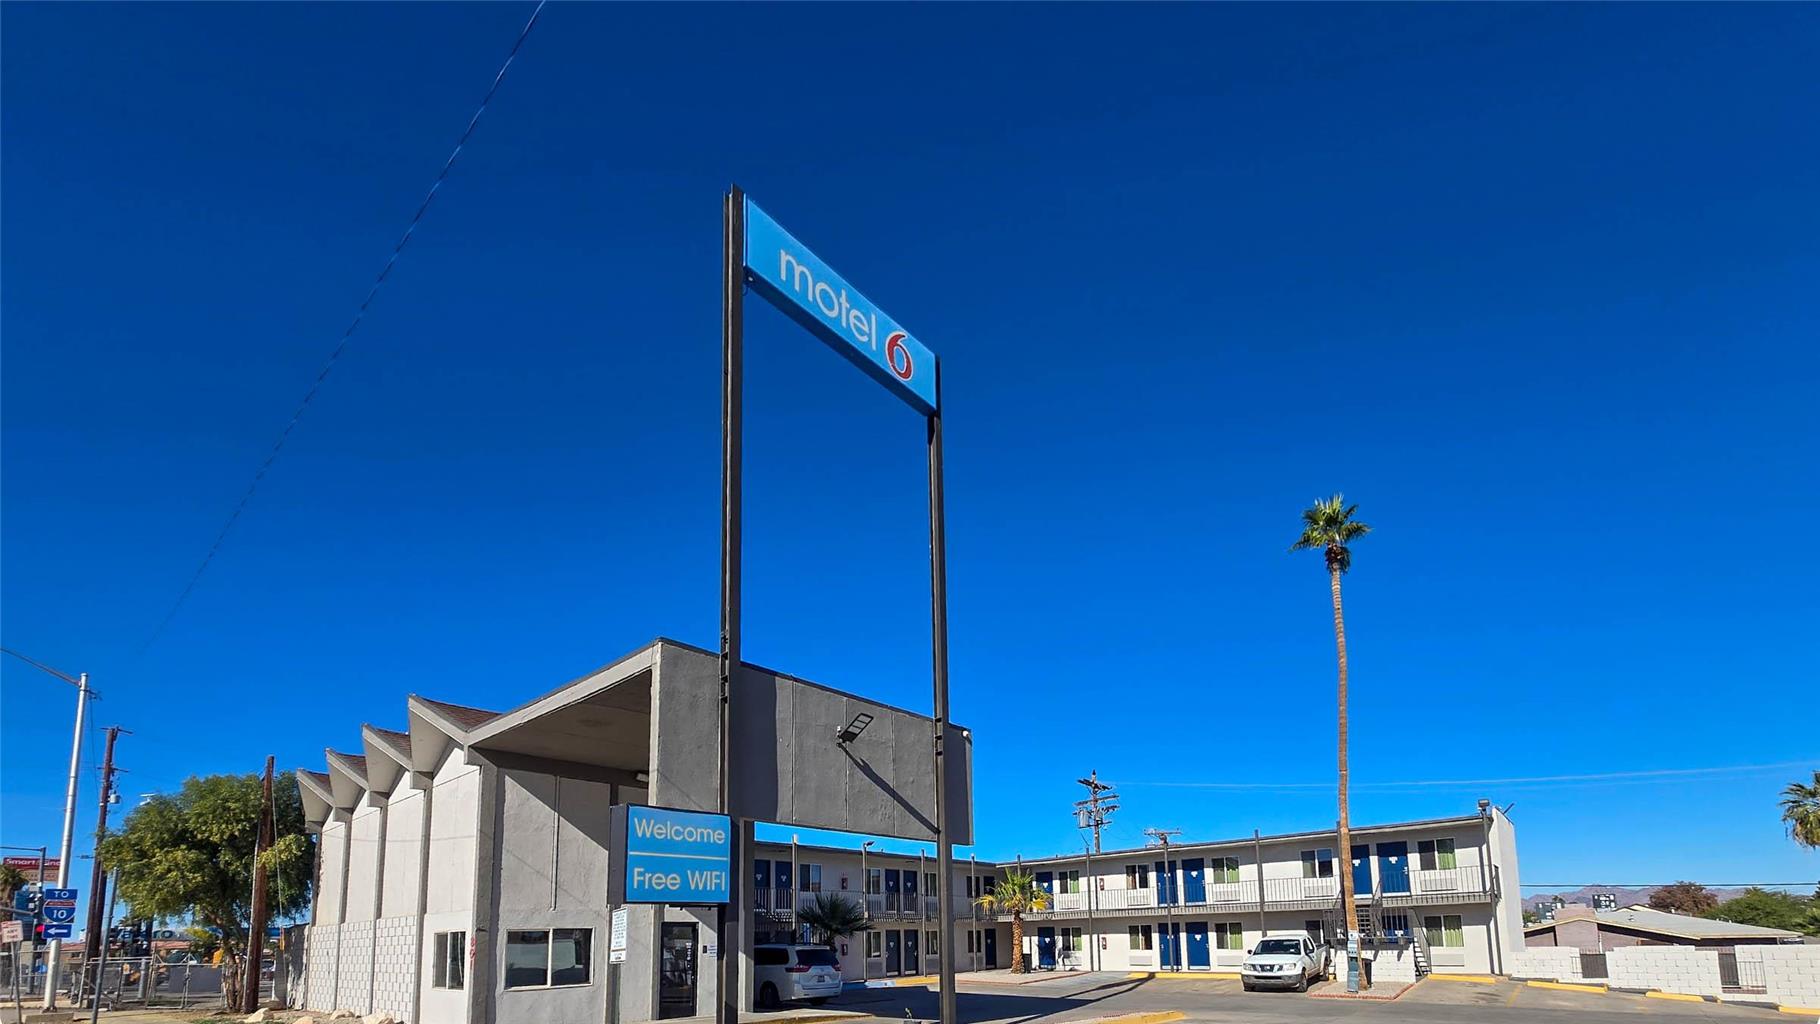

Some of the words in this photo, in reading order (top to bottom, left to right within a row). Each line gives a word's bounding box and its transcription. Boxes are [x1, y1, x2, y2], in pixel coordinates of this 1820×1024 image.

[779, 249, 877, 351] motel
[885, 331, 914, 382] 6
[633, 817, 726, 845] Welcome
[633, 867, 681, 890] Free
[688, 870, 726, 892] WIFI
[53, 910, 67, 919] 10
